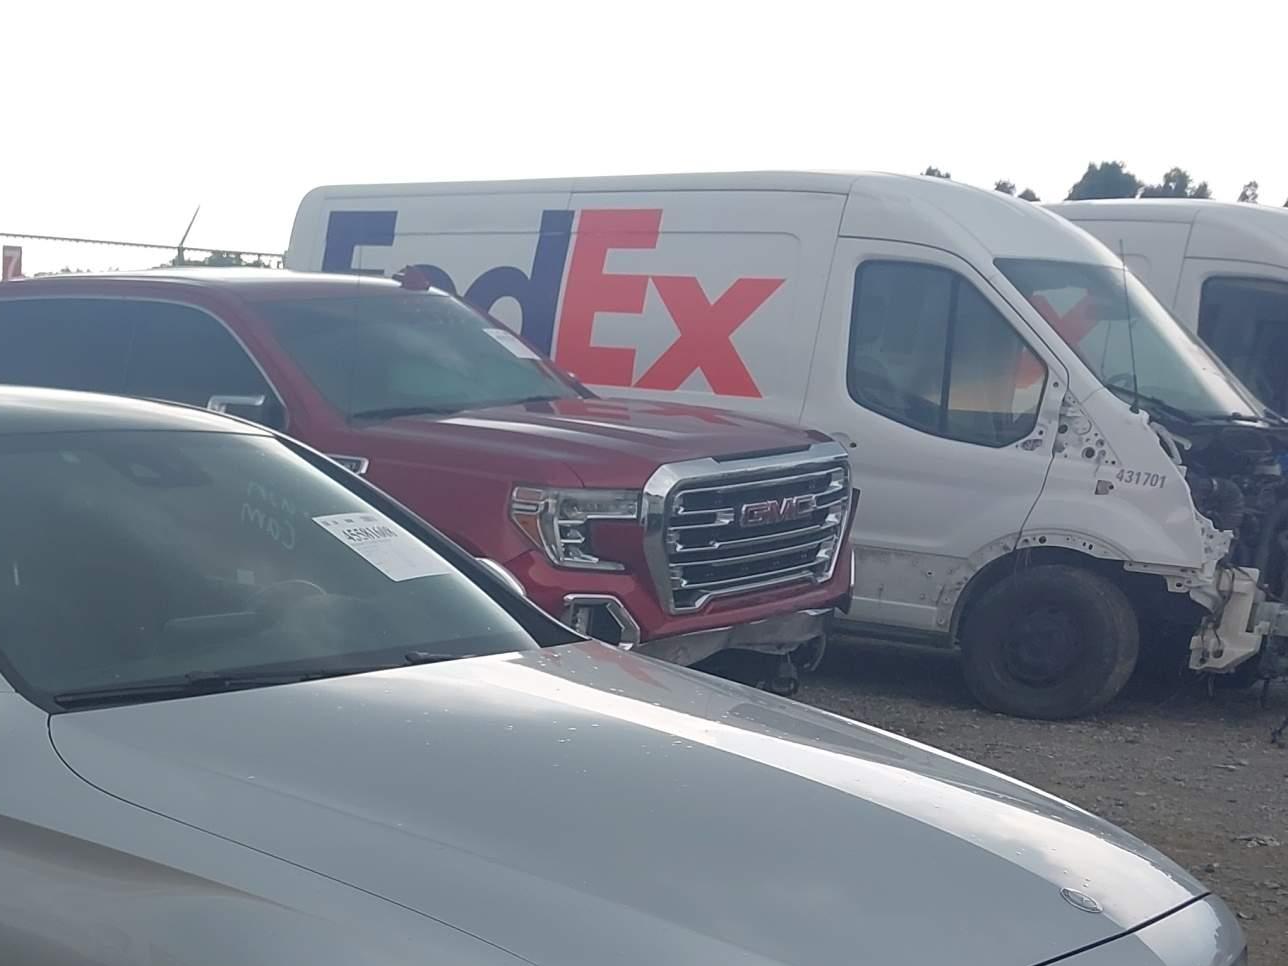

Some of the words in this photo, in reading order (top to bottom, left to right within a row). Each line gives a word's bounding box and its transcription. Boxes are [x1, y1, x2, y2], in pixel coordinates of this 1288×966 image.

[4, 250, 19, 280] 7
[321, 208, 786, 398] FdEx
[1116, 469, 1167, 488] 431701
[740, 494, 817, 527] GMC
